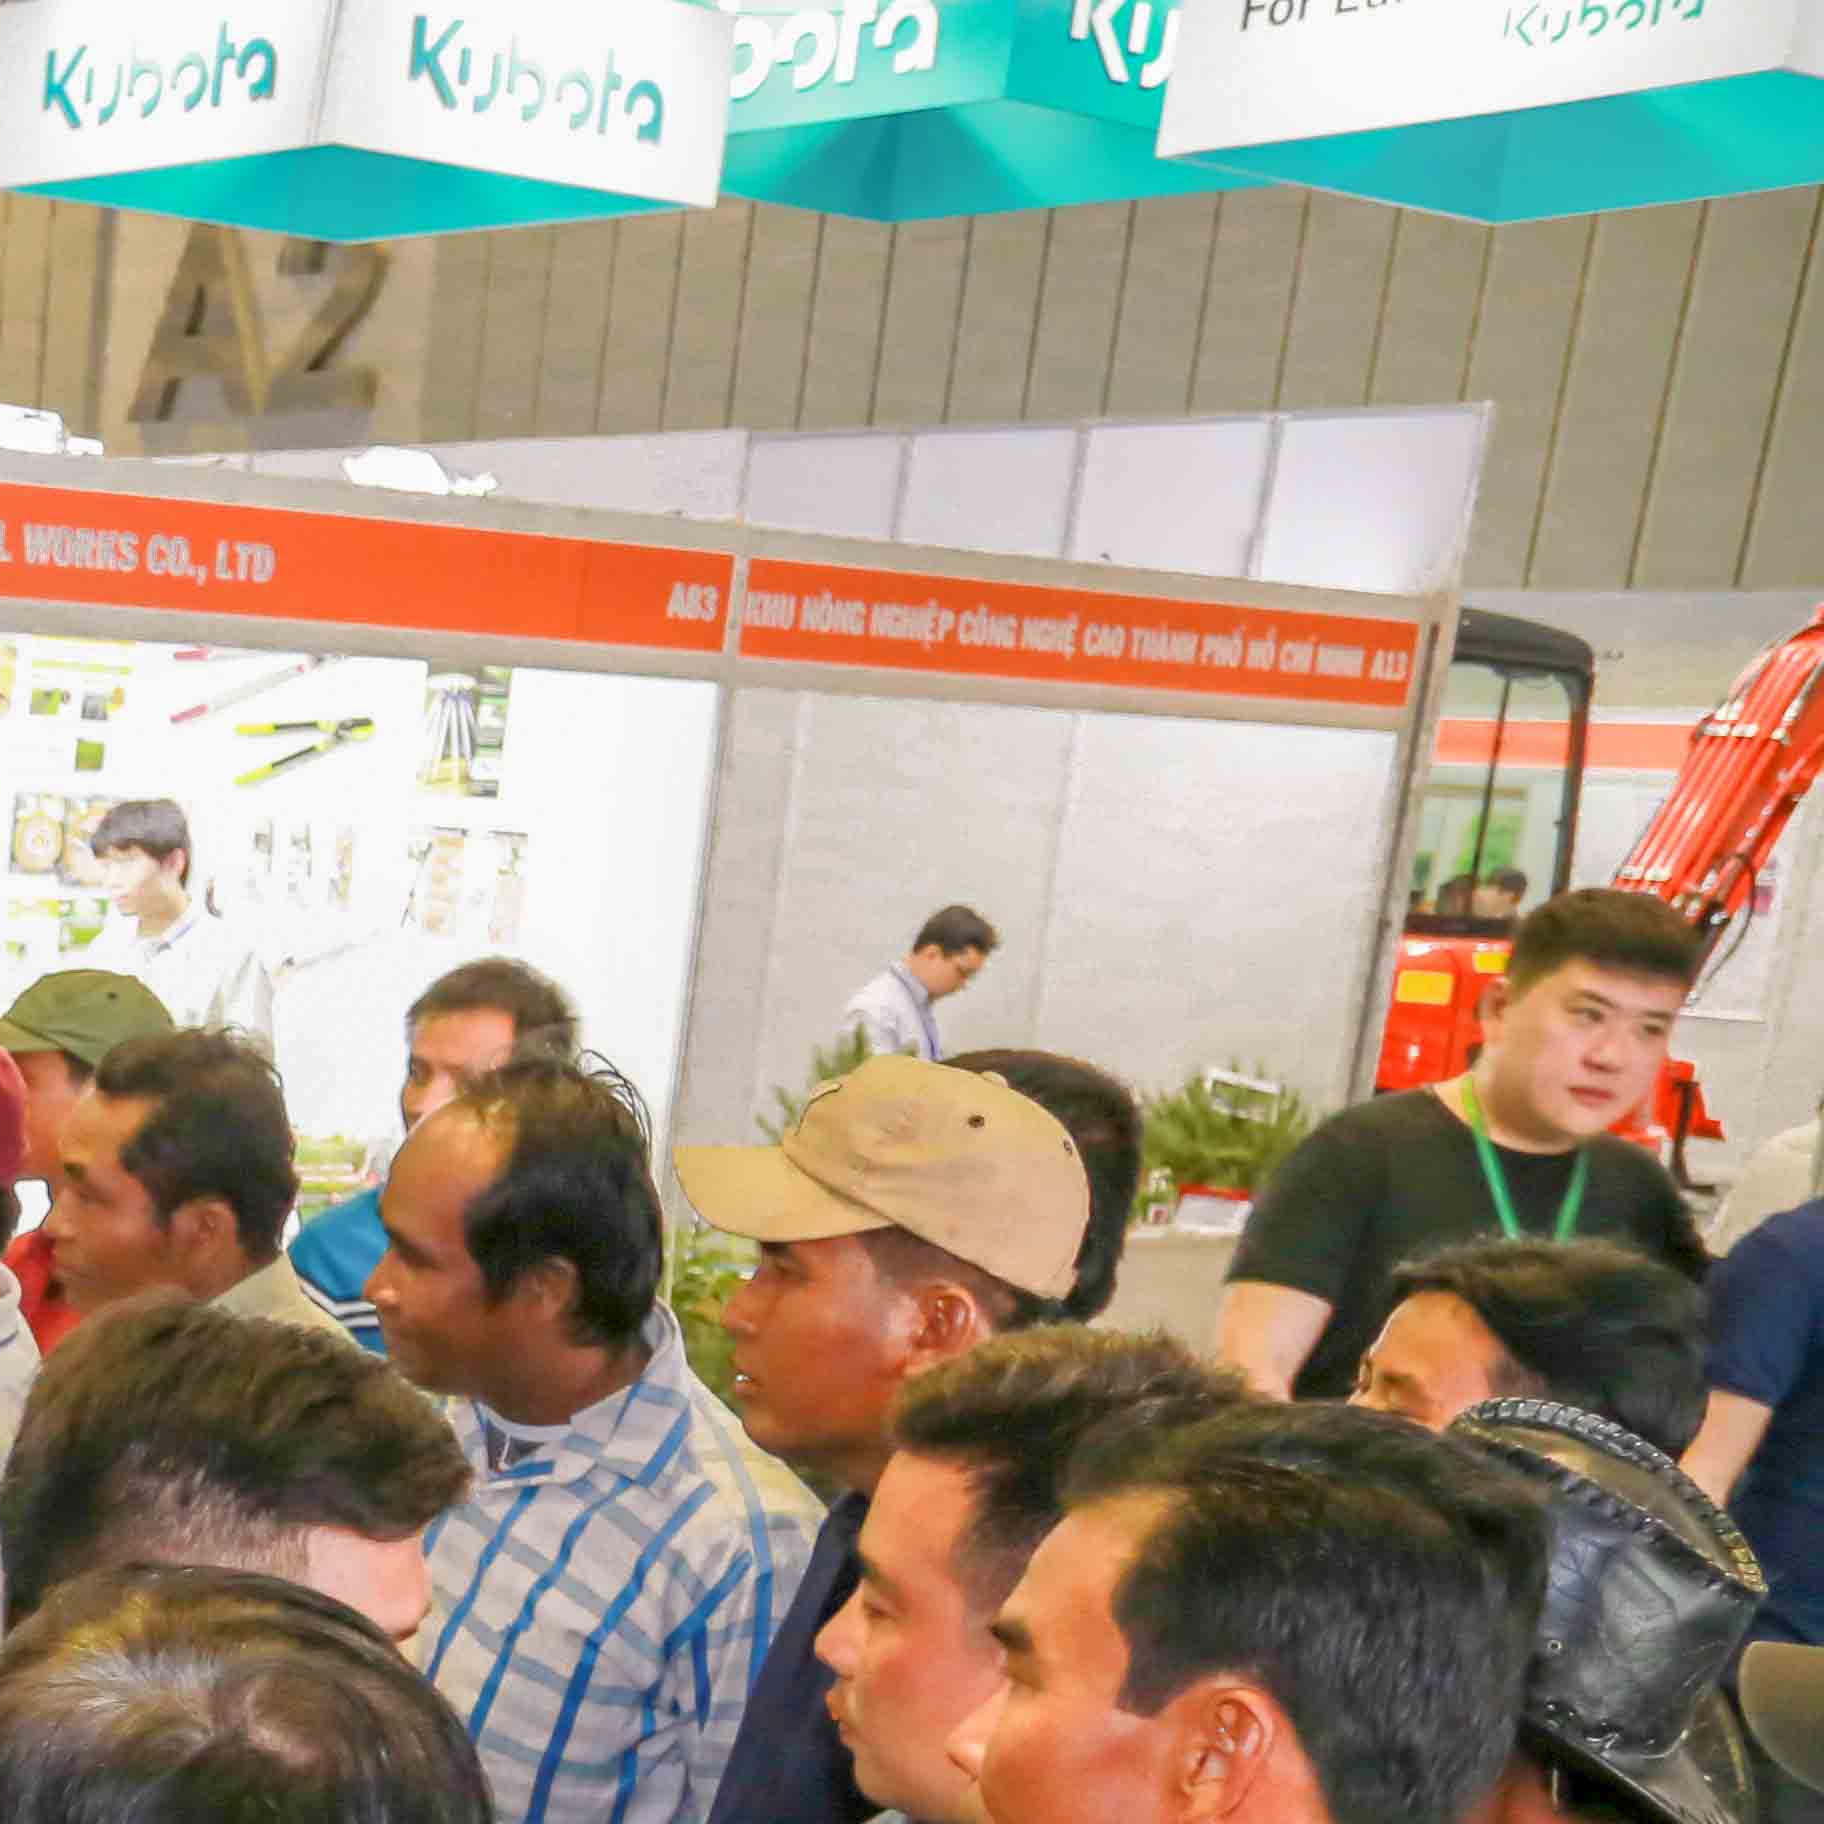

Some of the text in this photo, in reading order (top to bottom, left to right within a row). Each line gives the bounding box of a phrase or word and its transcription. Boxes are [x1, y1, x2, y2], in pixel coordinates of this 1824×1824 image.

[43, 21, 277, 128] Kubota
[408, 14, 665, 143] Kubota
[127, 222, 392, 421] A2
[22, 522, 140, 573] WORKS
[146, 533, 208, 586] CO.,
[215, 540, 277, 583] LTD
[801, 589, 866, 636] NÔNG
[870, 597, 956, 652] NGHIỆP
[958, 603, 1018, 648] CÔNG
[1083, 623, 1126, 657] CAO
